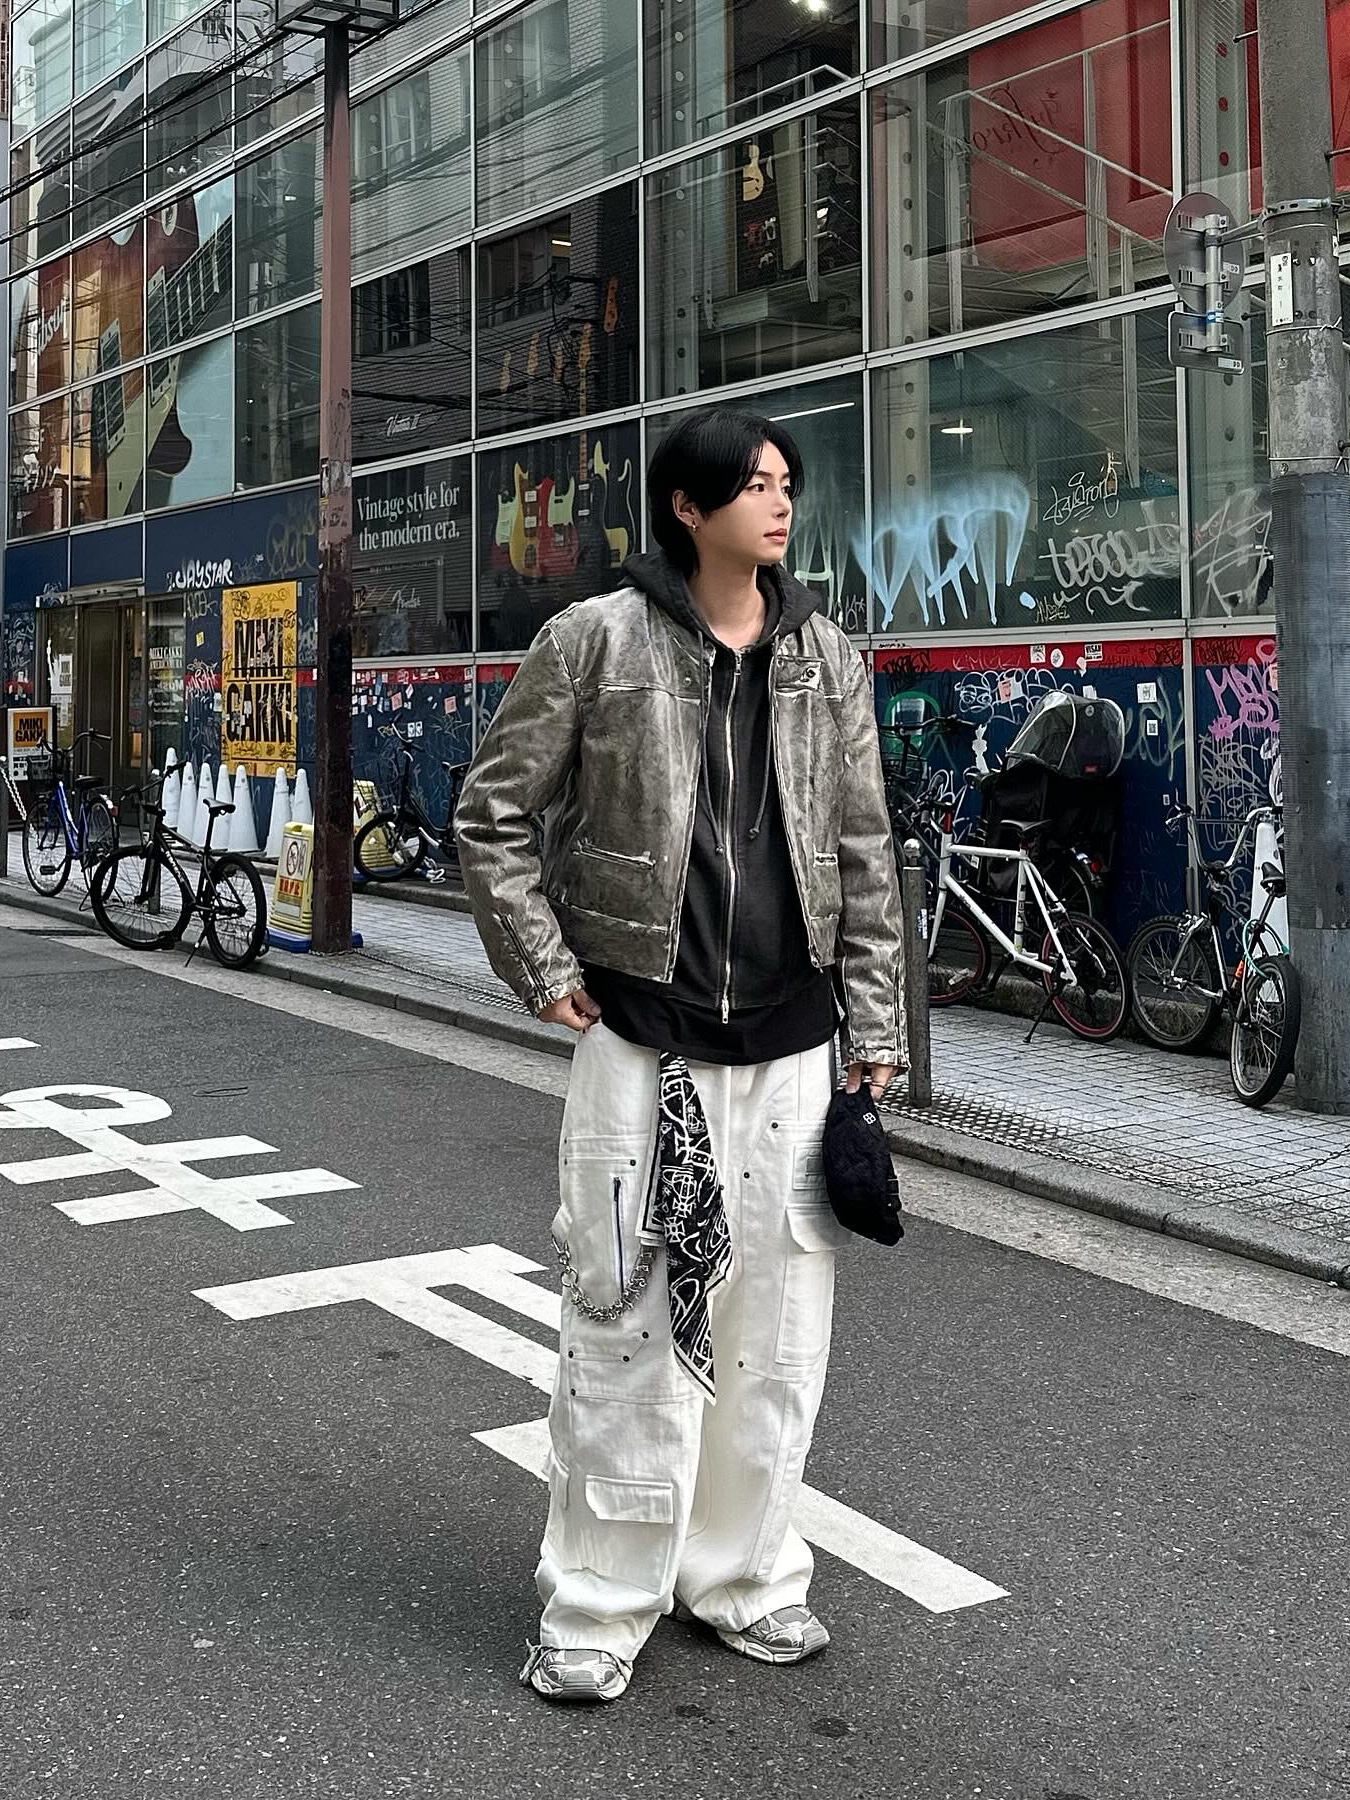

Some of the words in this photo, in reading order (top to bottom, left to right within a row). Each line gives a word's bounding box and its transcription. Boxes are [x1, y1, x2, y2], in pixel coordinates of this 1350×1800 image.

[357, 496, 405, 522] Vintage
[407, 485, 437, 519] style
[440, 481, 460, 508] for
[359, 527, 379, 551] the
[382, 520, 431, 548] modern
[435, 520, 460, 541] era.
[234, 617, 283, 678] MIKI
[19, 717, 43, 730] MIKI
[227, 683, 291, 742] GAKKI
